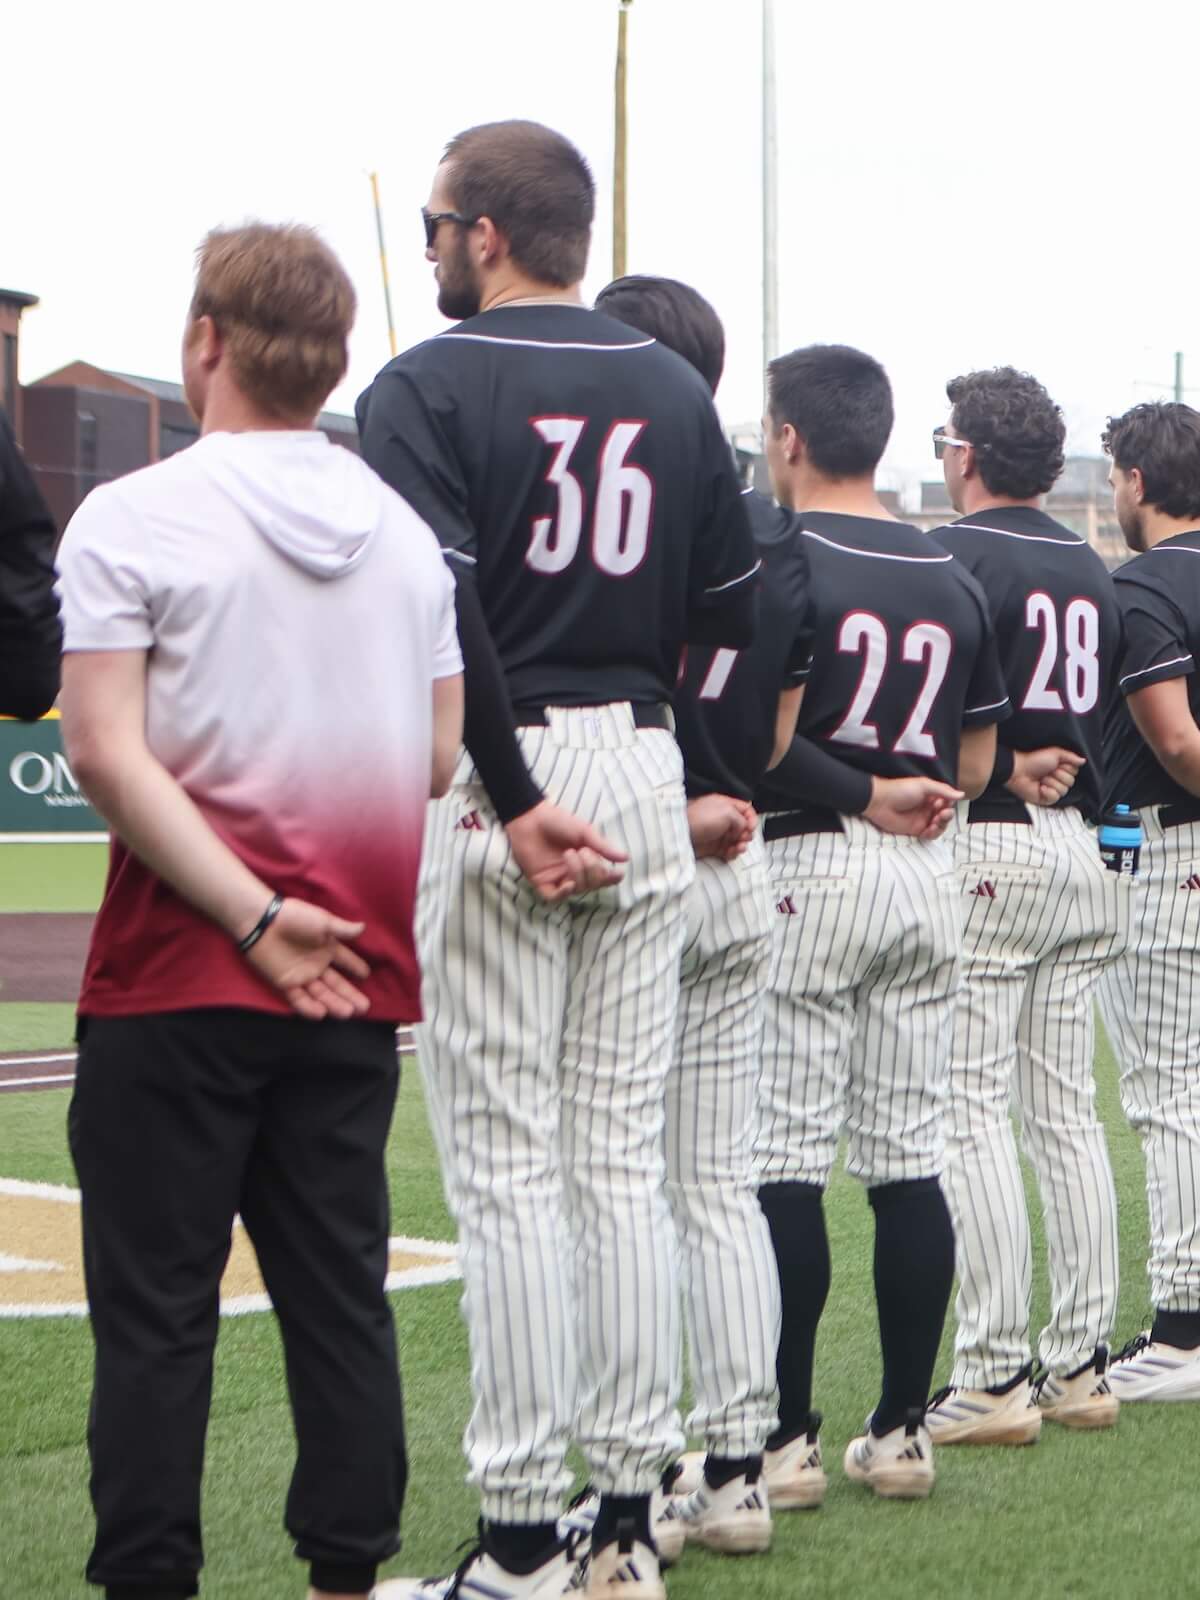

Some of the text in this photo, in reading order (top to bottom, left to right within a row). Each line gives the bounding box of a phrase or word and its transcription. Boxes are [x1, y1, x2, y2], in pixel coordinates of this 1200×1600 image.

[524, 414, 655, 577] 36
[826, 608, 957, 760] 22
[1019, 589, 1101, 716] 28
